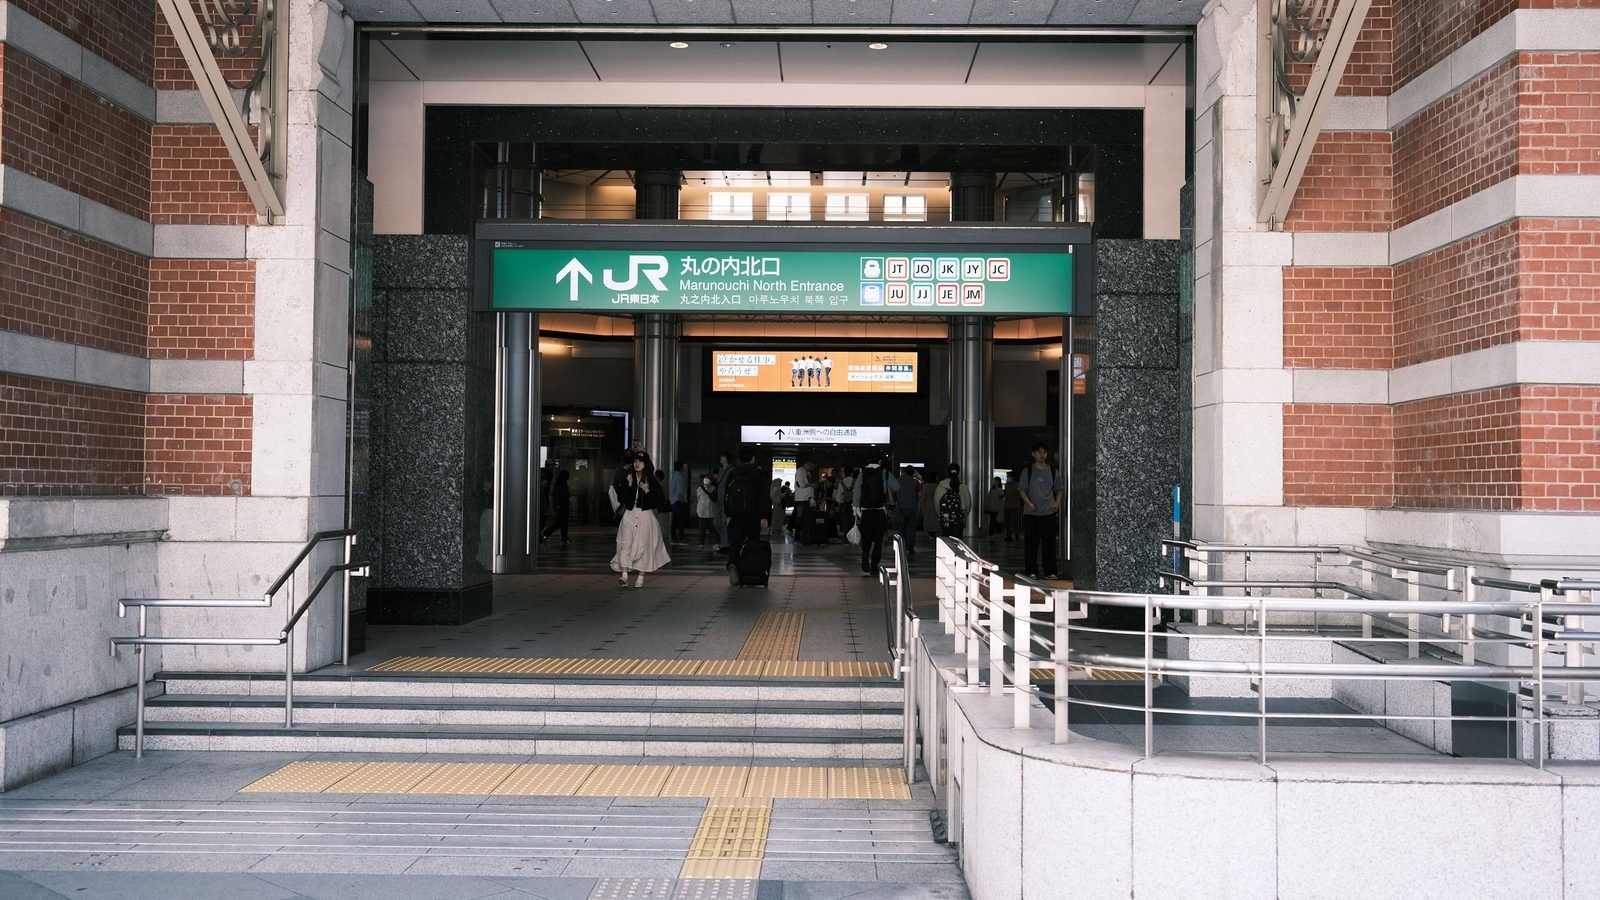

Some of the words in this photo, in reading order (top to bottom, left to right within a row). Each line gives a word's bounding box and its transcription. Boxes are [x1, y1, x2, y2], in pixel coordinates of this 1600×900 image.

[680, 256, 780, 277] 丸の内北口
[891, 264, 903, 274] JT
[915, 264, 930, 274] JO
[941, 264, 954, 274] JK
[966, 264, 980, 275] JY
[992, 264, 1005, 275] JC
[603, 255, 669, 291] JR
[679, 279, 750, 291] Marunouchi
[753, 280, 787, 291] North
[790, 280, 844, 292] Entrance
[611, 294, 660, 304] JR東日本
[680, 294, 741, 305] 丸之内北入口
[748, 294, 800, 305] 마루노우치
[804, 295, 825, 305] 북쪽
[828, 295, 849, 306] 입구
[890, 289, 904, 299] JU
[917, 290, 928, 299] JJ
[942, 290, 954, 300] JE
[965, 290, 981, 300] JM
[787, 428, 858, 437] 八重洲側への自由通路
